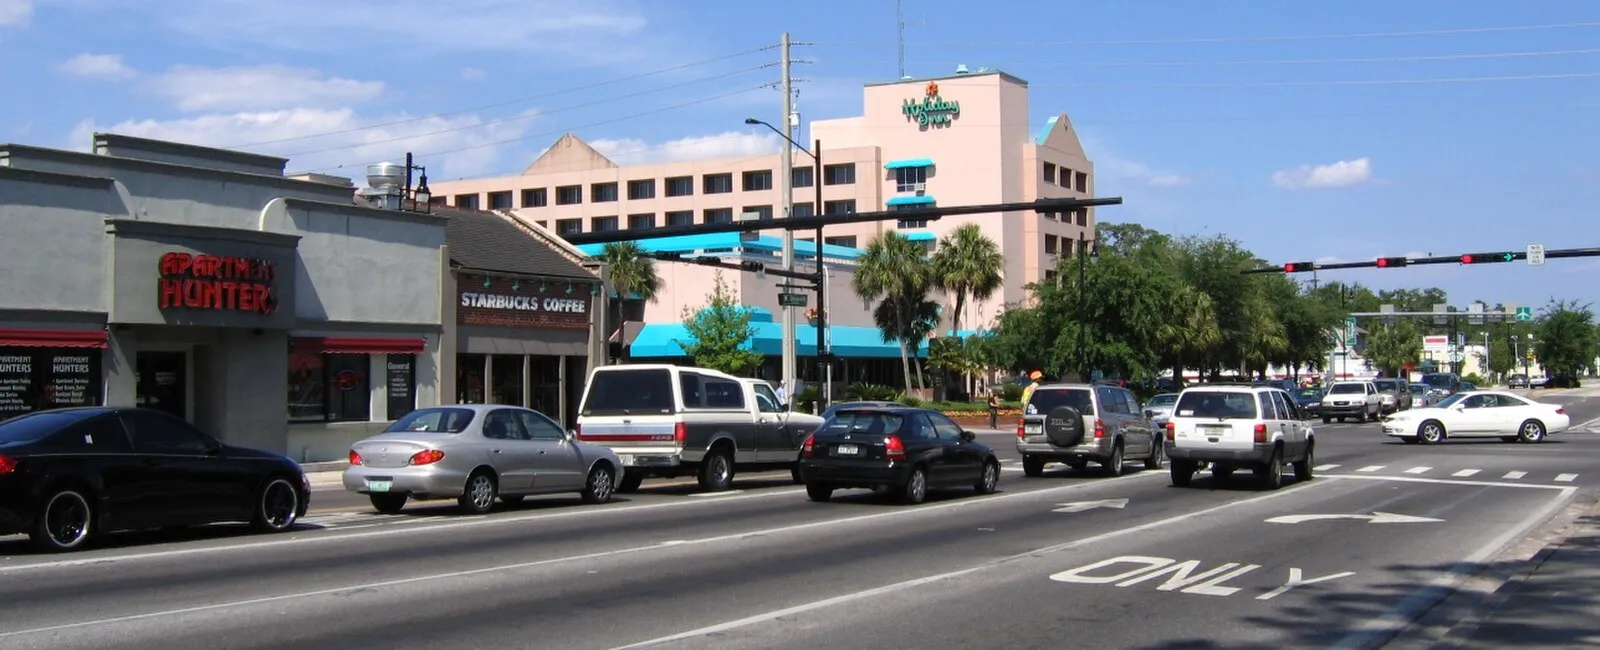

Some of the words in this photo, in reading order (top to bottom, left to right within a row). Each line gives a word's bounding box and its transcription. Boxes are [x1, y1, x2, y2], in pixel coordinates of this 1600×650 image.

[902, 96, 960, 119] Holiday
[919, 111, 951, 128] Inn
[461, 292, 538, 311] STARBUCKS
[543, 297, 585, 313] COFFEE
[52, 363, 89, 373] HUNTERS
[387, 361, 410, 370] General
[1049, 556, 1356, 600] ONLY
